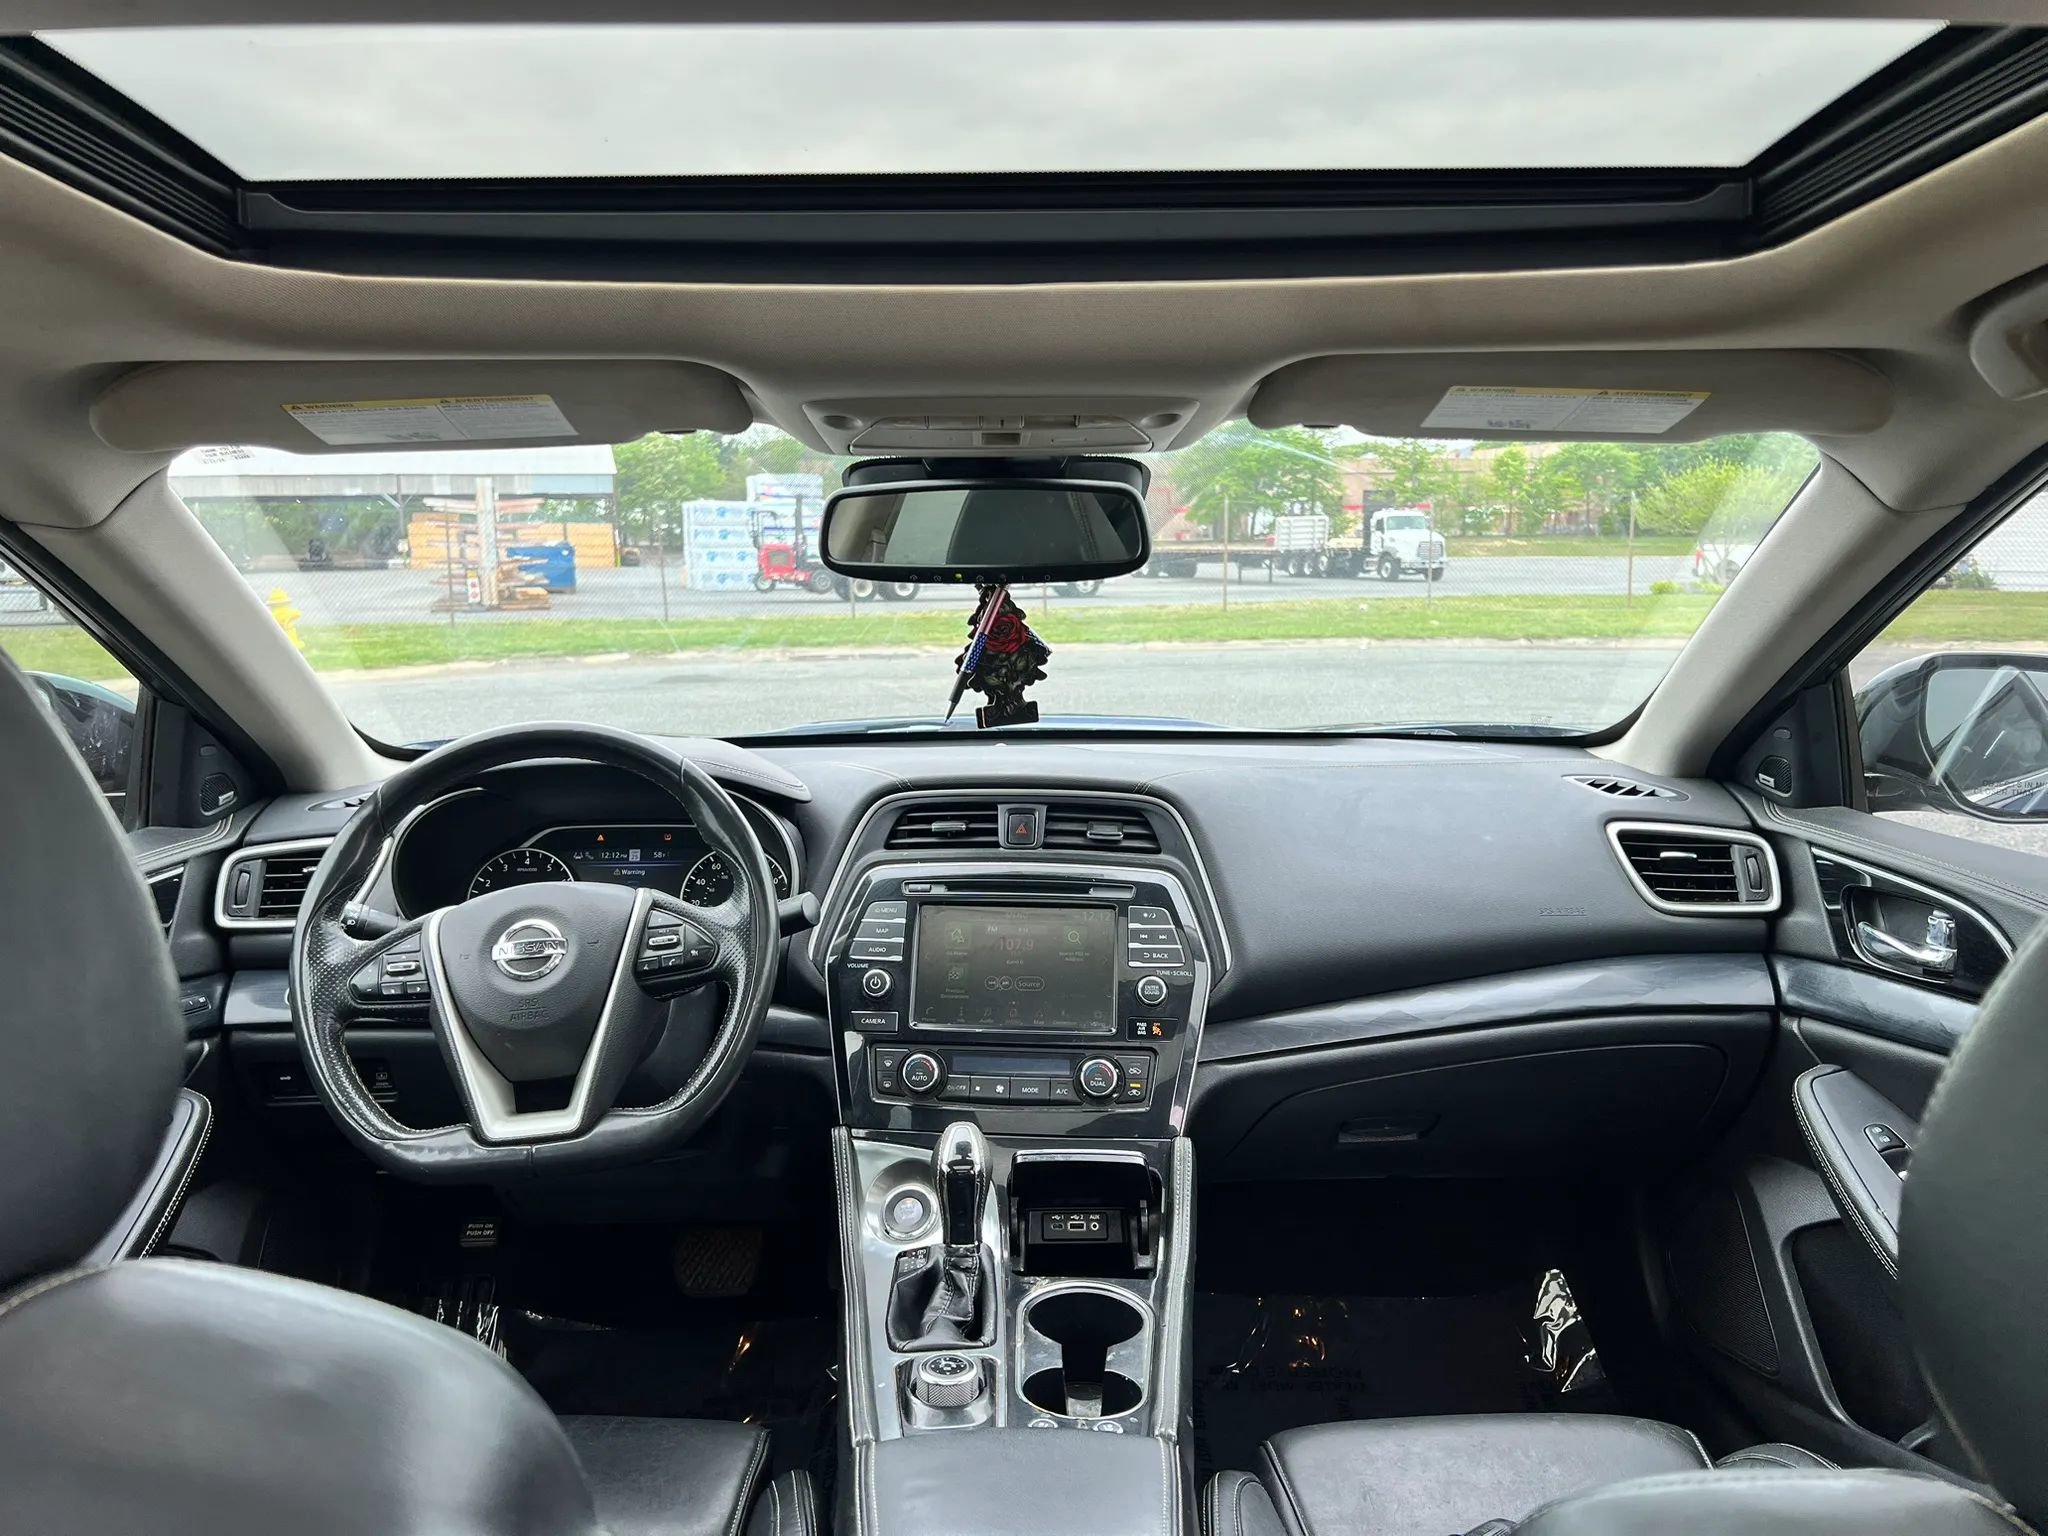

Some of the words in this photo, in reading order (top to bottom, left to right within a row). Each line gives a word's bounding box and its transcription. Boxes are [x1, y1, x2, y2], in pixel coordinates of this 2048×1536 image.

[503, 864, 508, 872] 3
[546, 864, 552, 872] 5
[498, 940, 560, 953] NISSAN
[1018, 980, 1041, 988] Source
